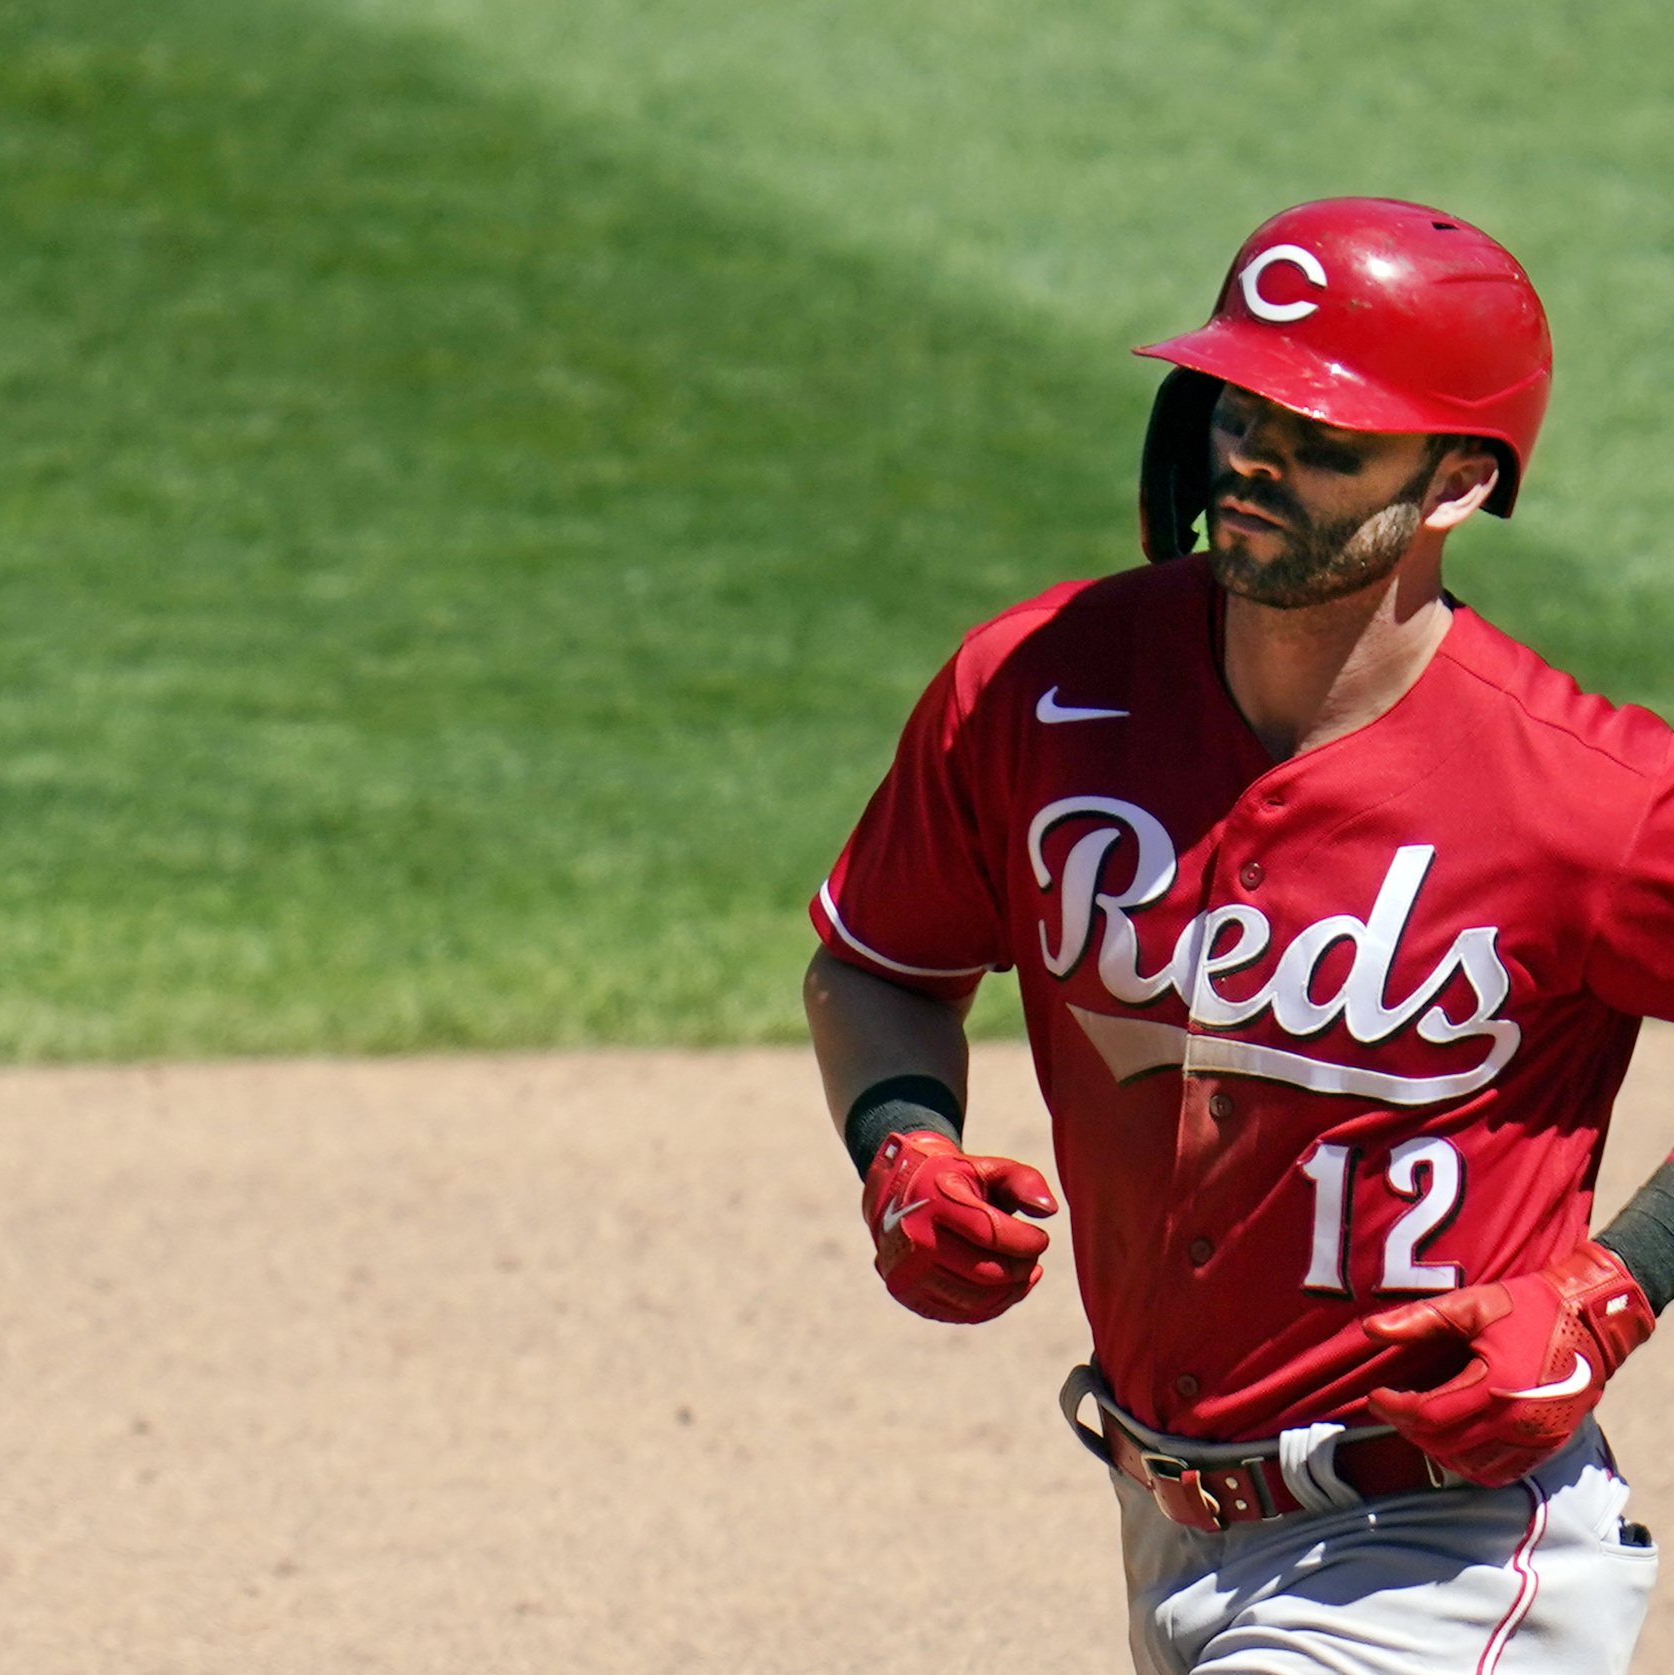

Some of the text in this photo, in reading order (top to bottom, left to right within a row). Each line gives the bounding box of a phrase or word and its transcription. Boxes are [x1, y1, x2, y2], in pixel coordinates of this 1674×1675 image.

[1238, 243, 1328, 323] C
[1028, 795, 1521, 1105] Reds
[1298, 1135, 1467, 1300] 12
